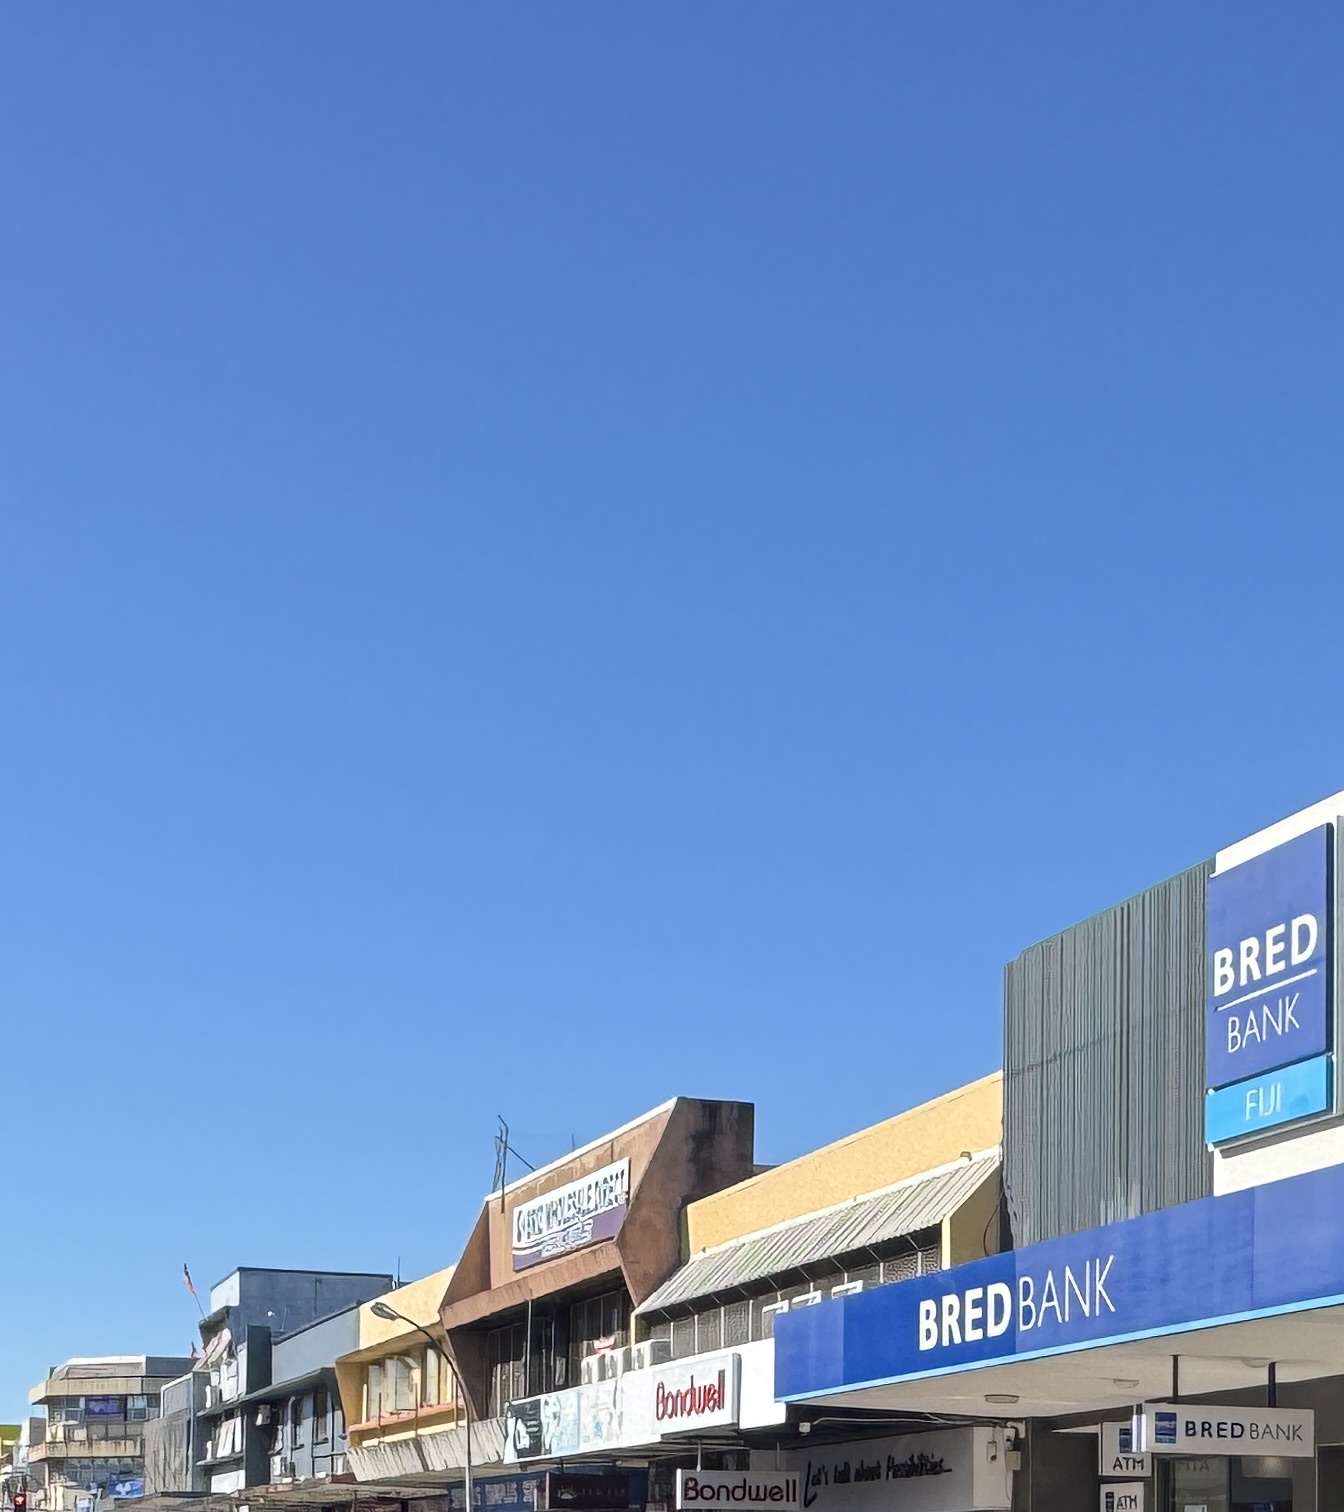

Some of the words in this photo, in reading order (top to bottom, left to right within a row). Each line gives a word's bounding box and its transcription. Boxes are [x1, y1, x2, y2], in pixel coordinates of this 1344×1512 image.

[1214, 913, 1318, 997] BRED
[1228, 993, 1300, 1053] BANK
[1245, 1081, 1282, 1121] FIJI
[918, 1282, 1012, 1351] BRED
[1019, 1254, 1117, 1332] BANK
[656, 1369, 726, 1421] Bondwell
[1185, 1420, 1245, 1439] BRED
[1249, 1423, 1303, 1442] BANK
[1113, 1457, 1145, 1471] ATM
[685, 1477, 797, 1502] Bondwell
